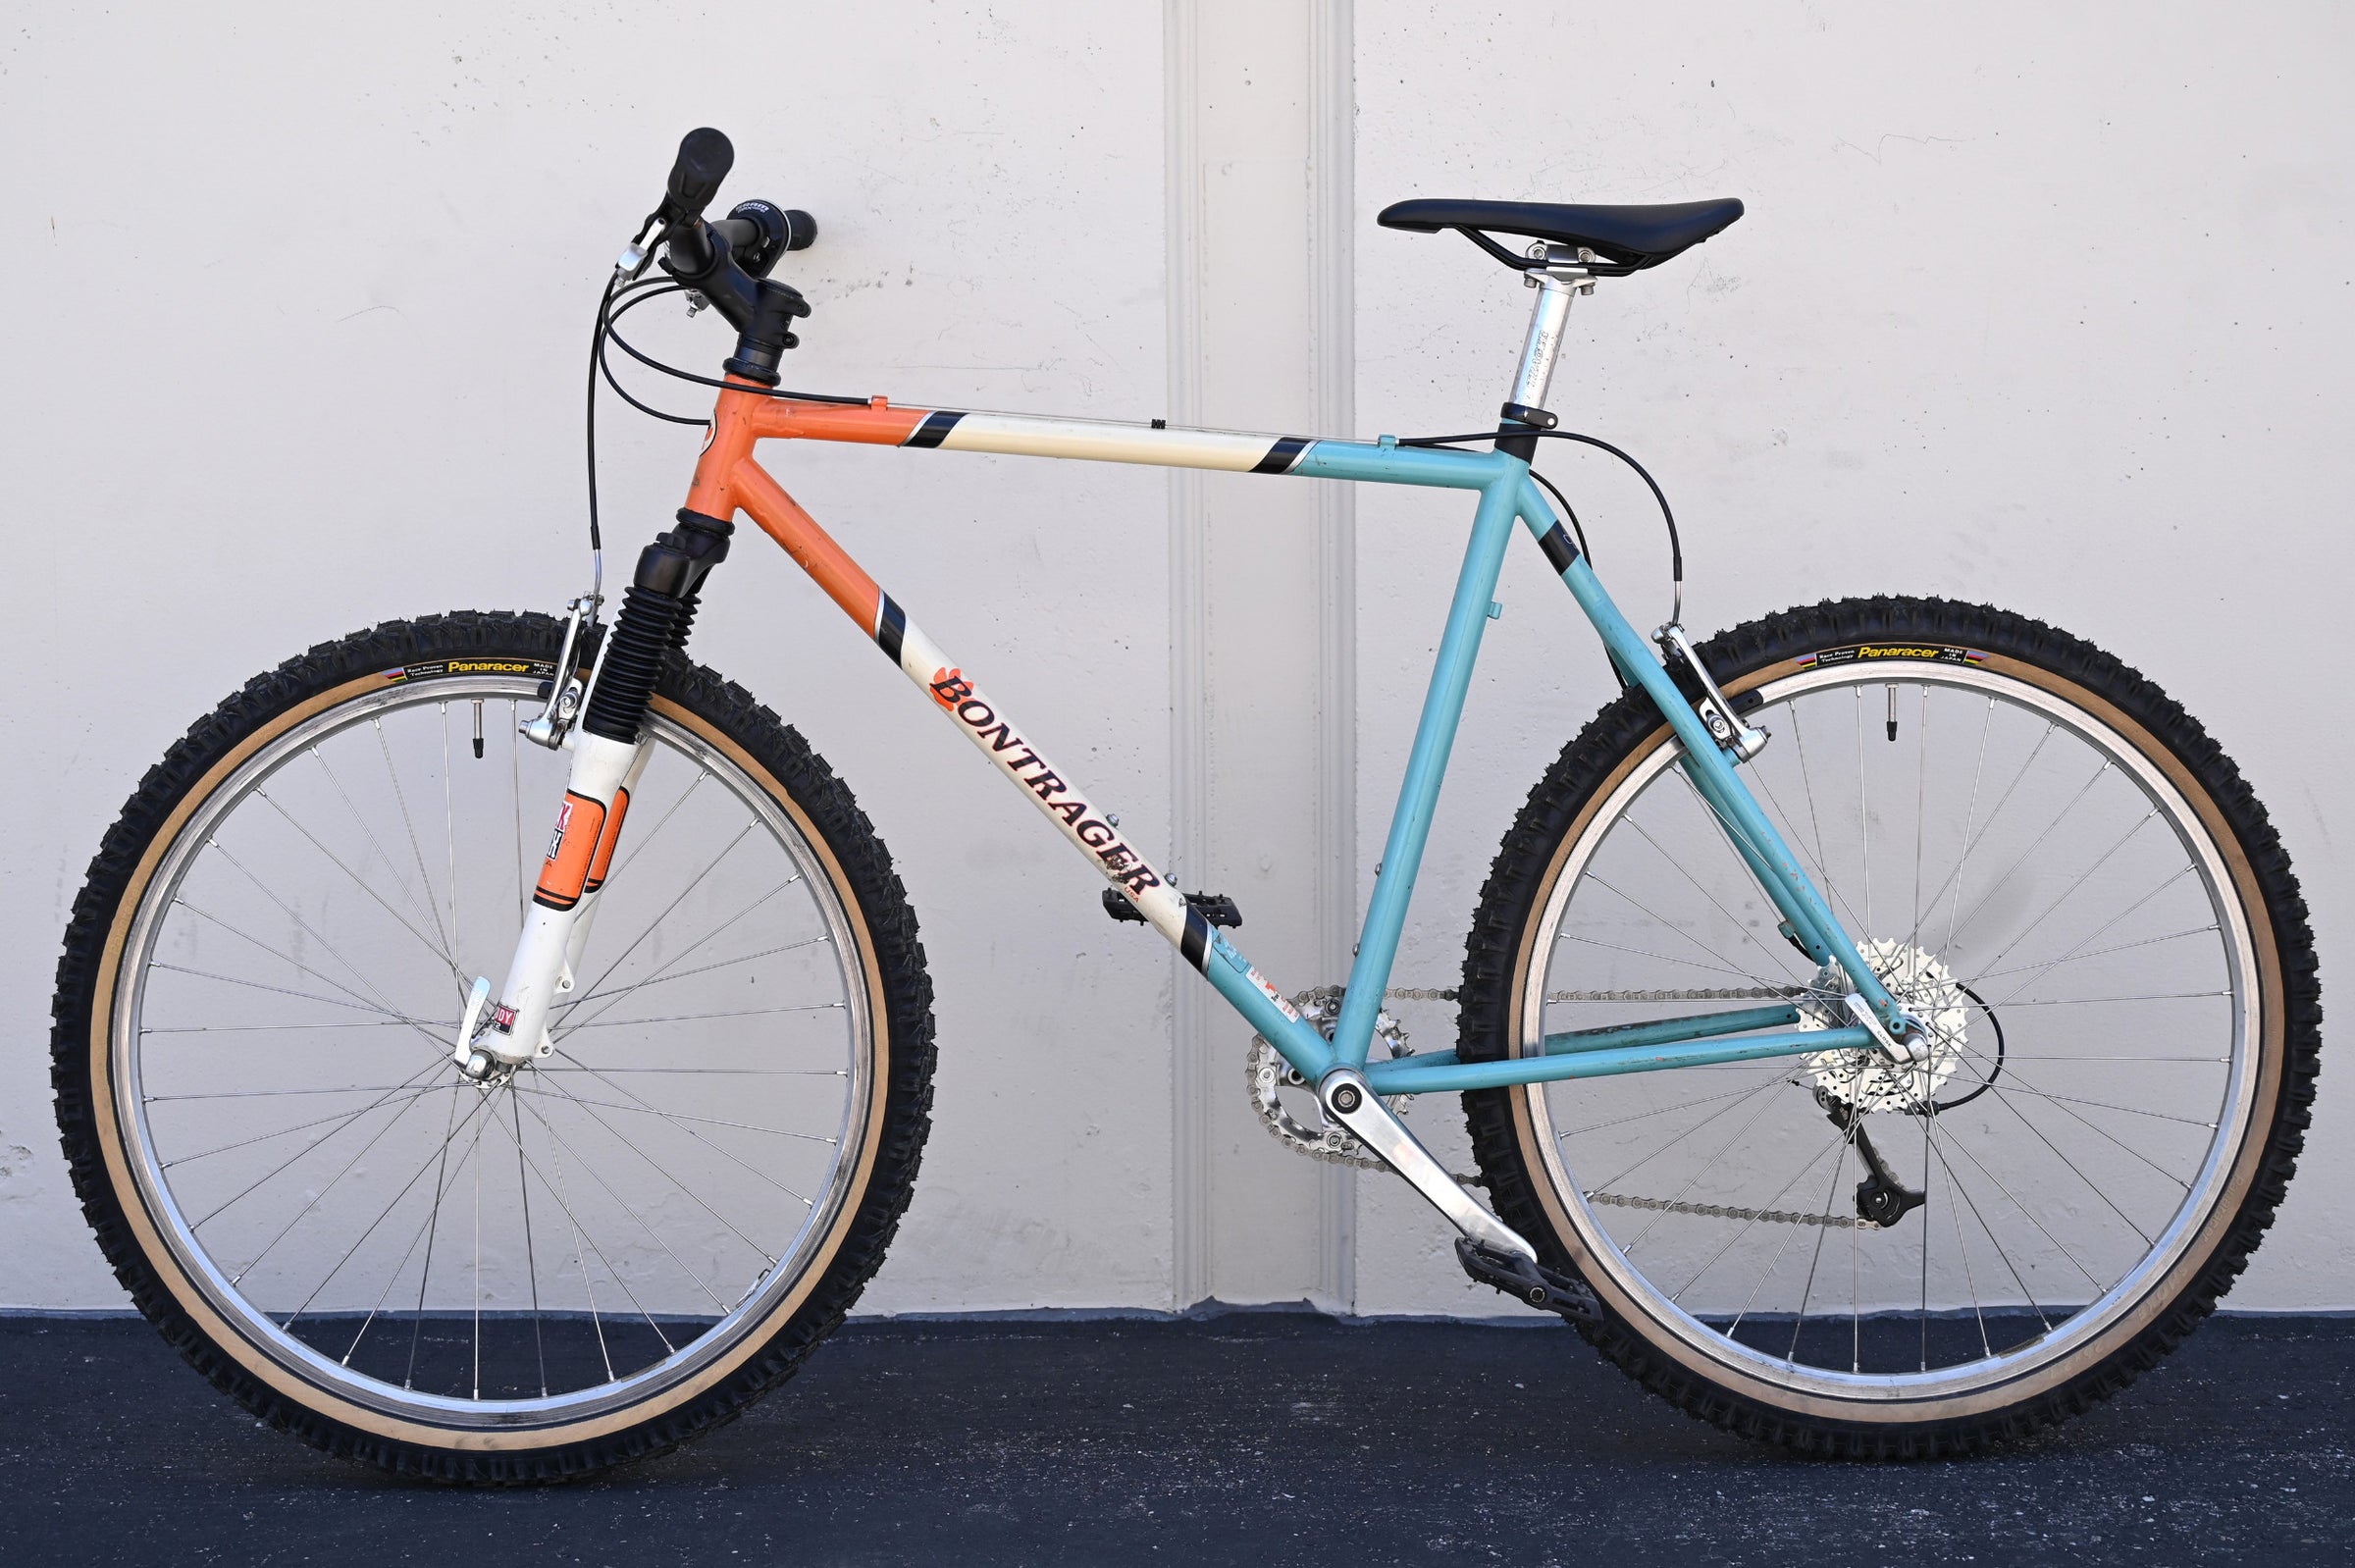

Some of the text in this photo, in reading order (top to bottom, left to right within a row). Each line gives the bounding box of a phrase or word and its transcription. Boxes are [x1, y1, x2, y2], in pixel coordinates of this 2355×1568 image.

[1858, 647, 1940, 658] Panaracer
[448, 661, 530, 673] Panaracer
[929, 675, 1160, 895] BONTRAGER
[1124, 885, 1139, 904] USA
